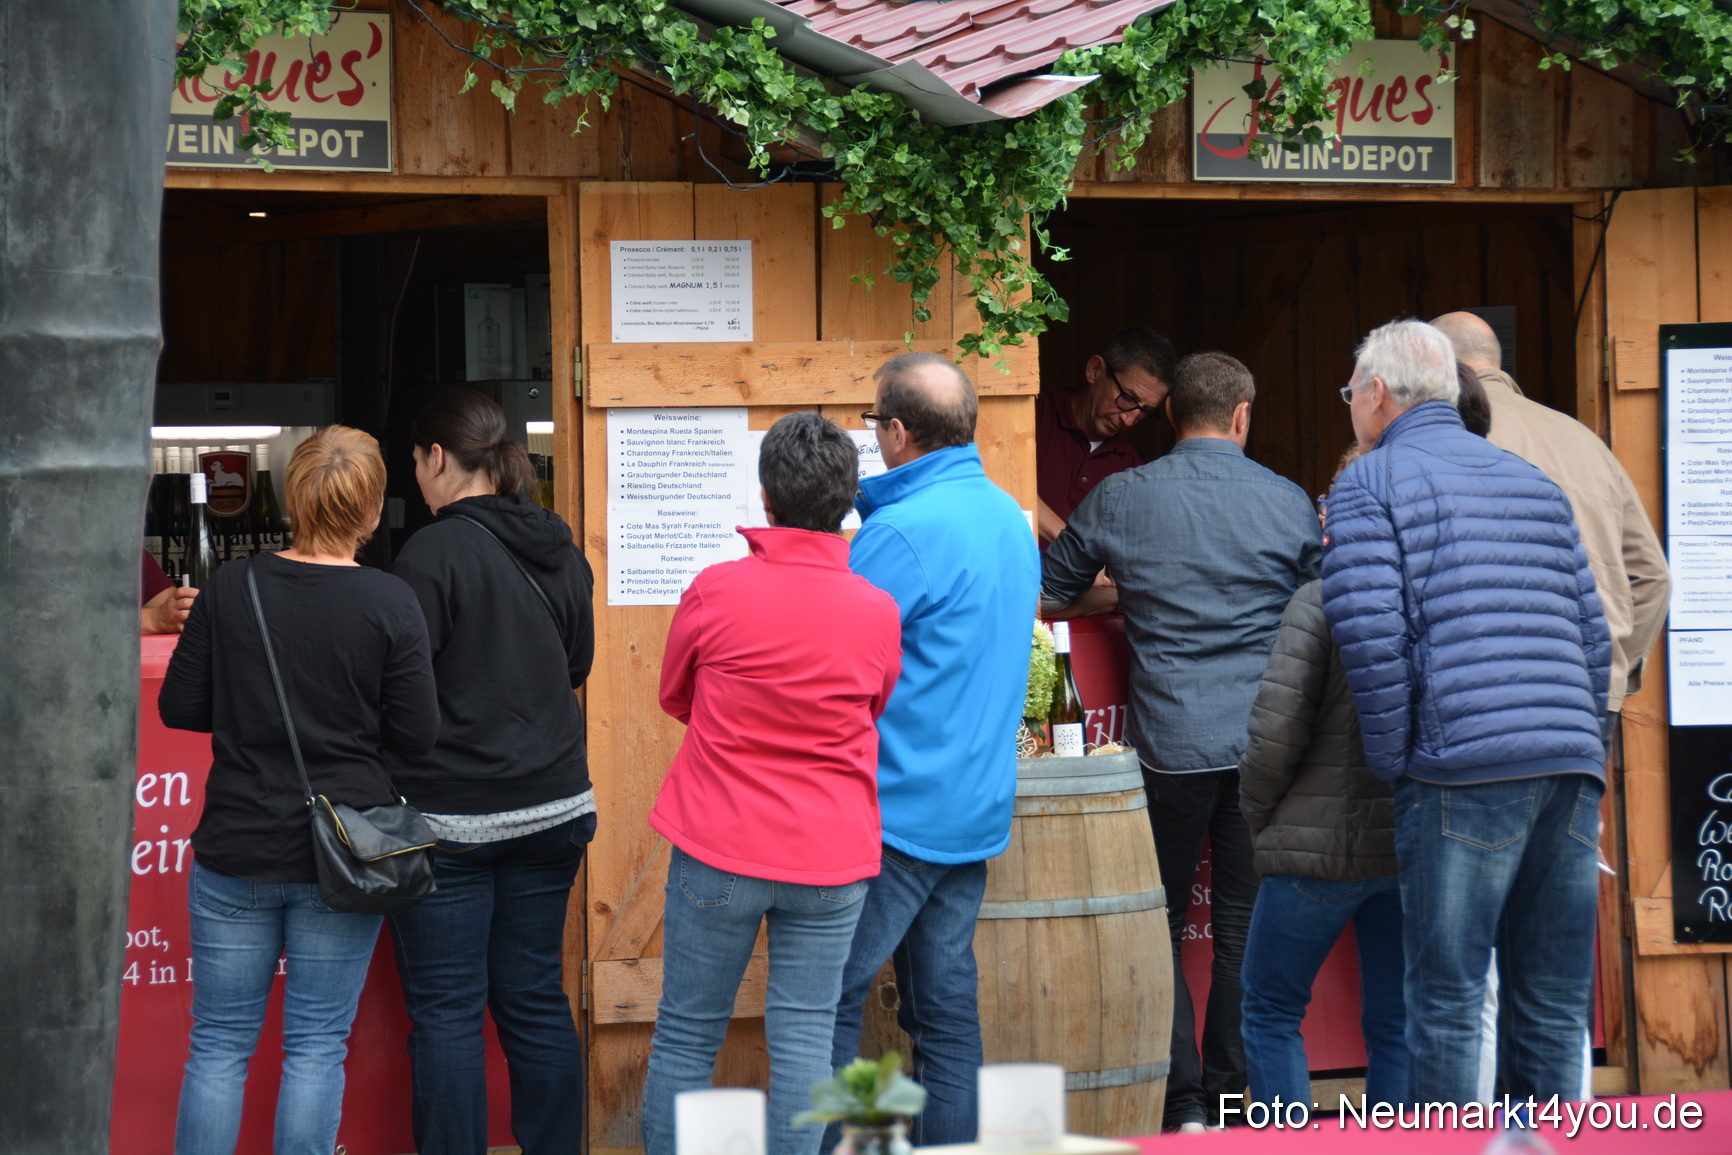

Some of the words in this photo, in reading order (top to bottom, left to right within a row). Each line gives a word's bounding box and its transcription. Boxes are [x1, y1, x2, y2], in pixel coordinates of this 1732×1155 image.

[1200, 48, 1449, 158] Jques'
[1260, 144, 1433, 171] WEIN-DEPOT
[215, 500, 237, 509] 1628
[150, 961, 176, 984] in
